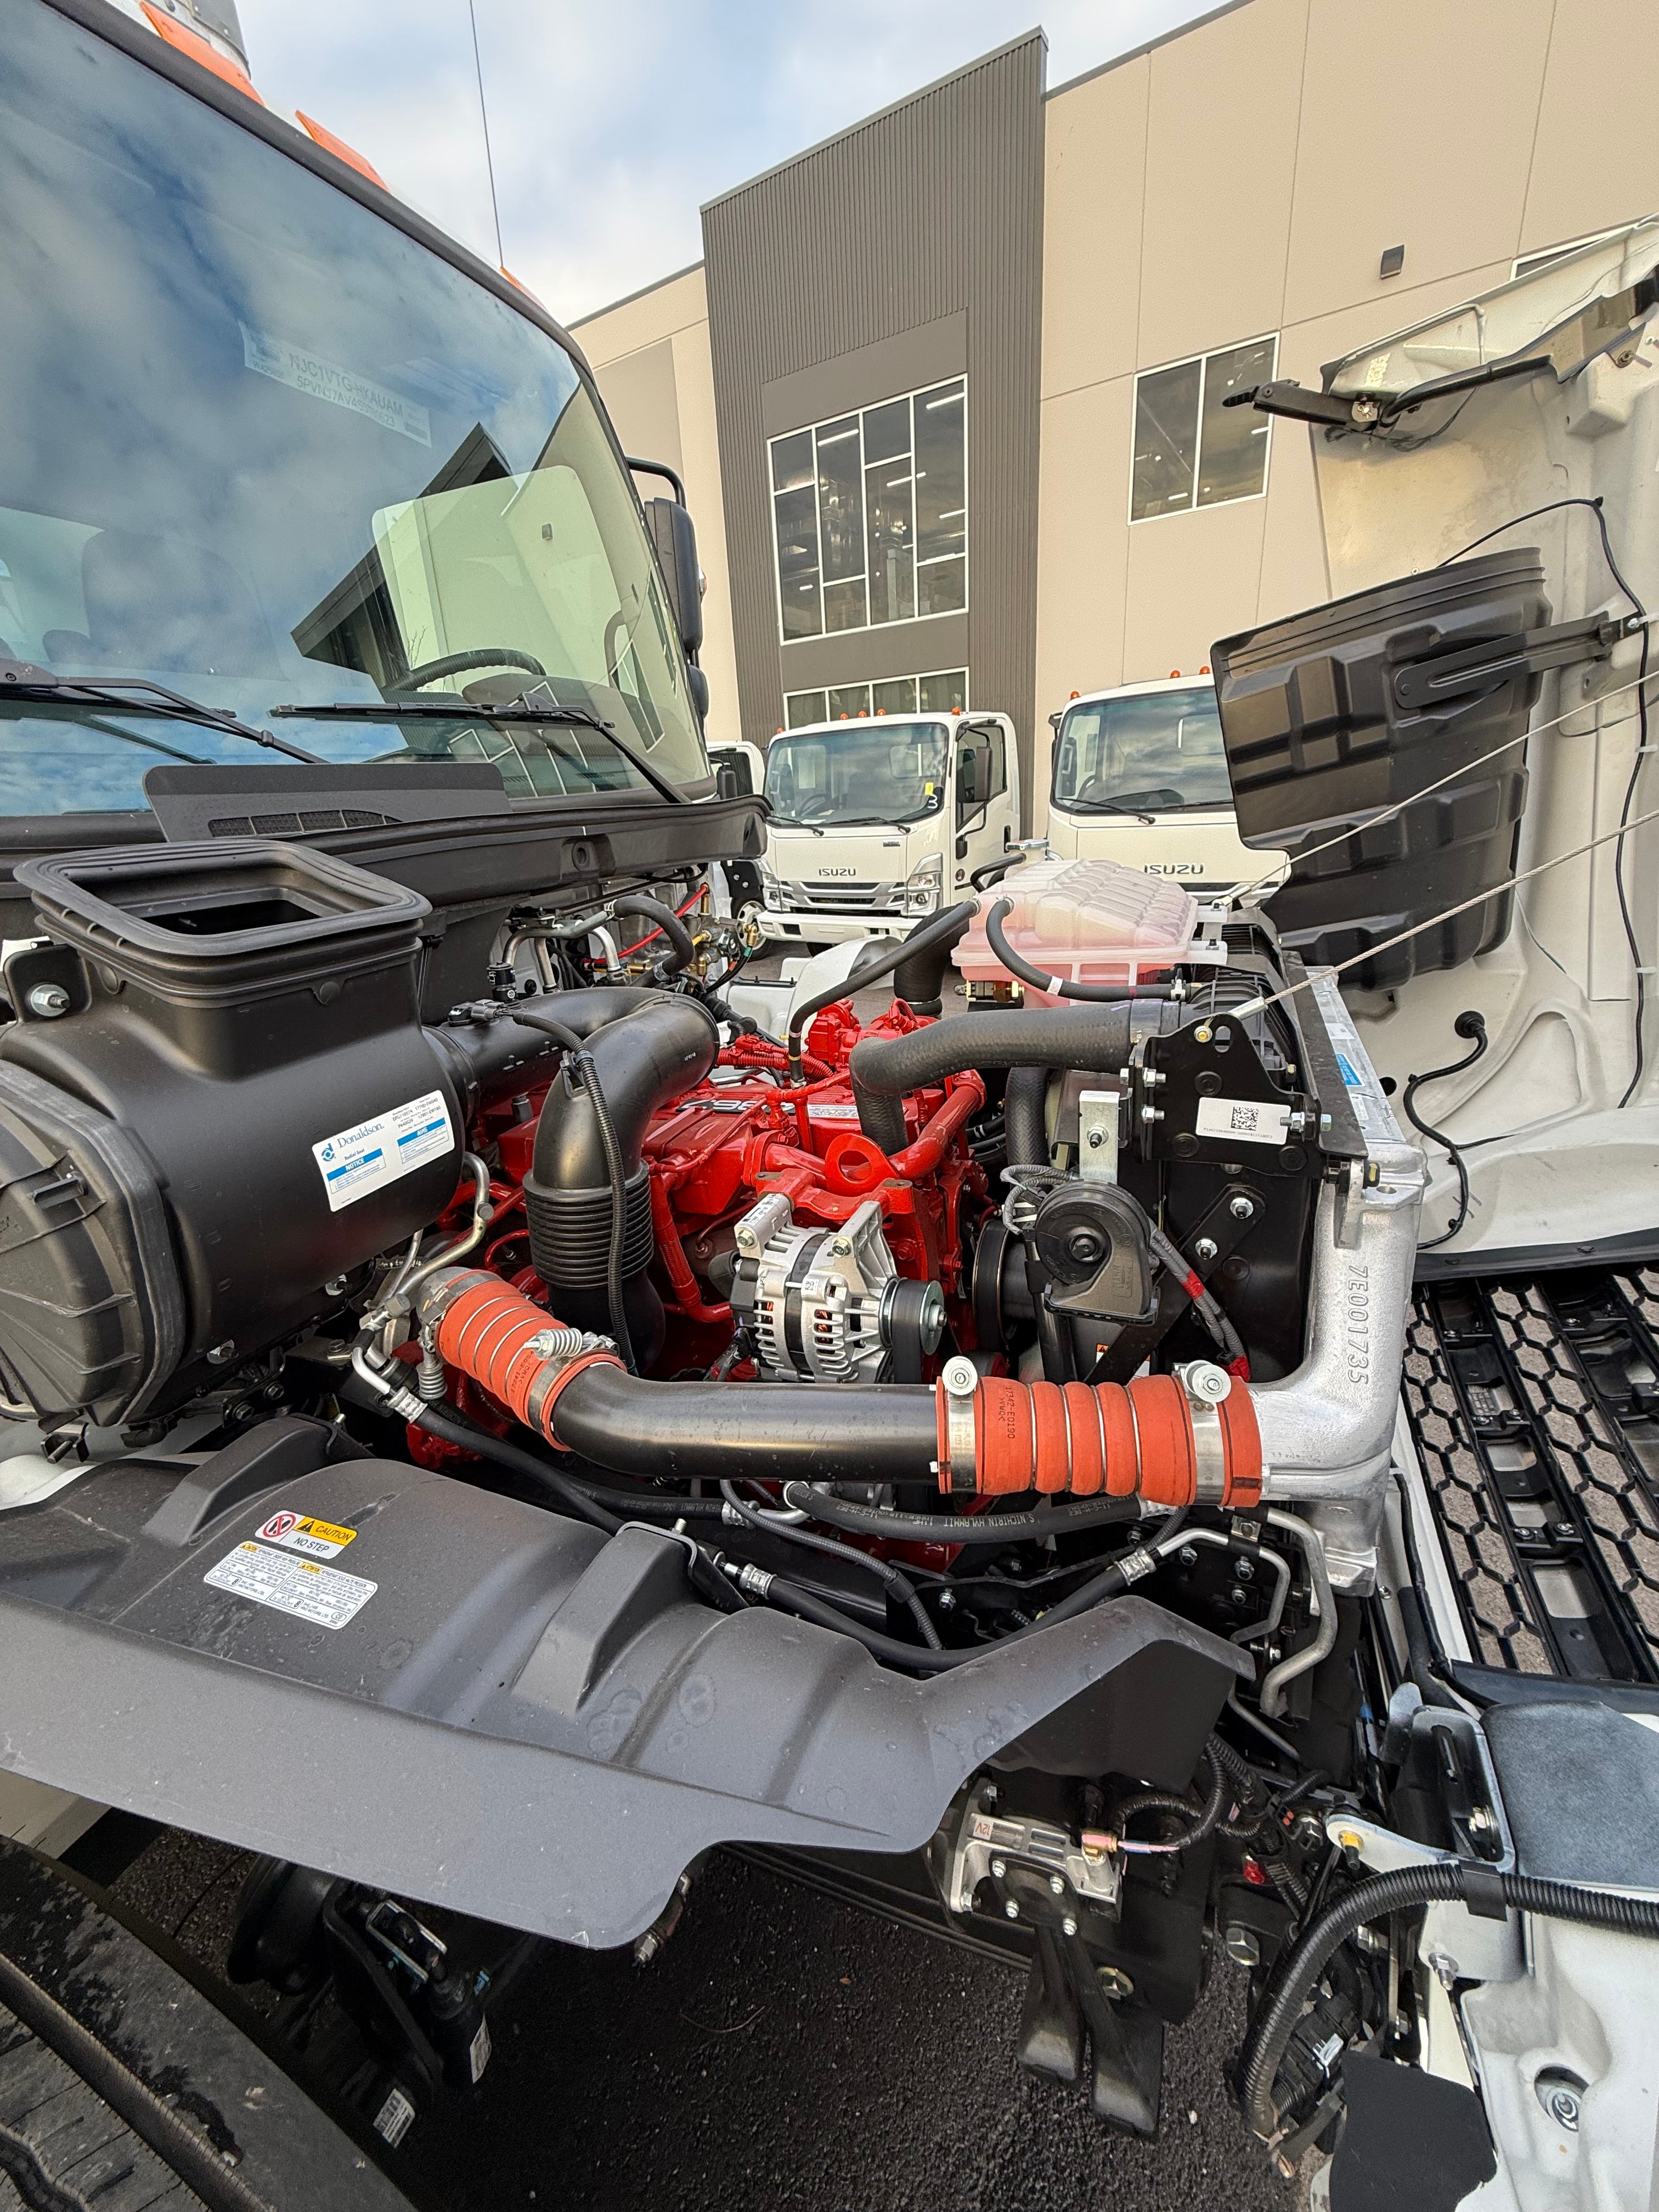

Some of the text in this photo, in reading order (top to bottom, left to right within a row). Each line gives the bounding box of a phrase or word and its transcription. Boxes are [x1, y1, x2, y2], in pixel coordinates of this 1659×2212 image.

[818, 867, 857, 877] ISUZU
[1144, 864, 1204, 875] ISUZU
[337, 1123, 383, 1148] Donaldson
[417, 1127, 428, 1136] AVIS
[345, 1157, 365, 1171] NOTICE
[1348, 1265, 1369, 1385] 7E001735
[943, 1517, 985, 1527] HYLAMMIT
[315, 1525, 352, 1541] CAUTION
[293, 1537, 330, 1553] NO STEP
[975, 1821, 991, 1836] 12V
